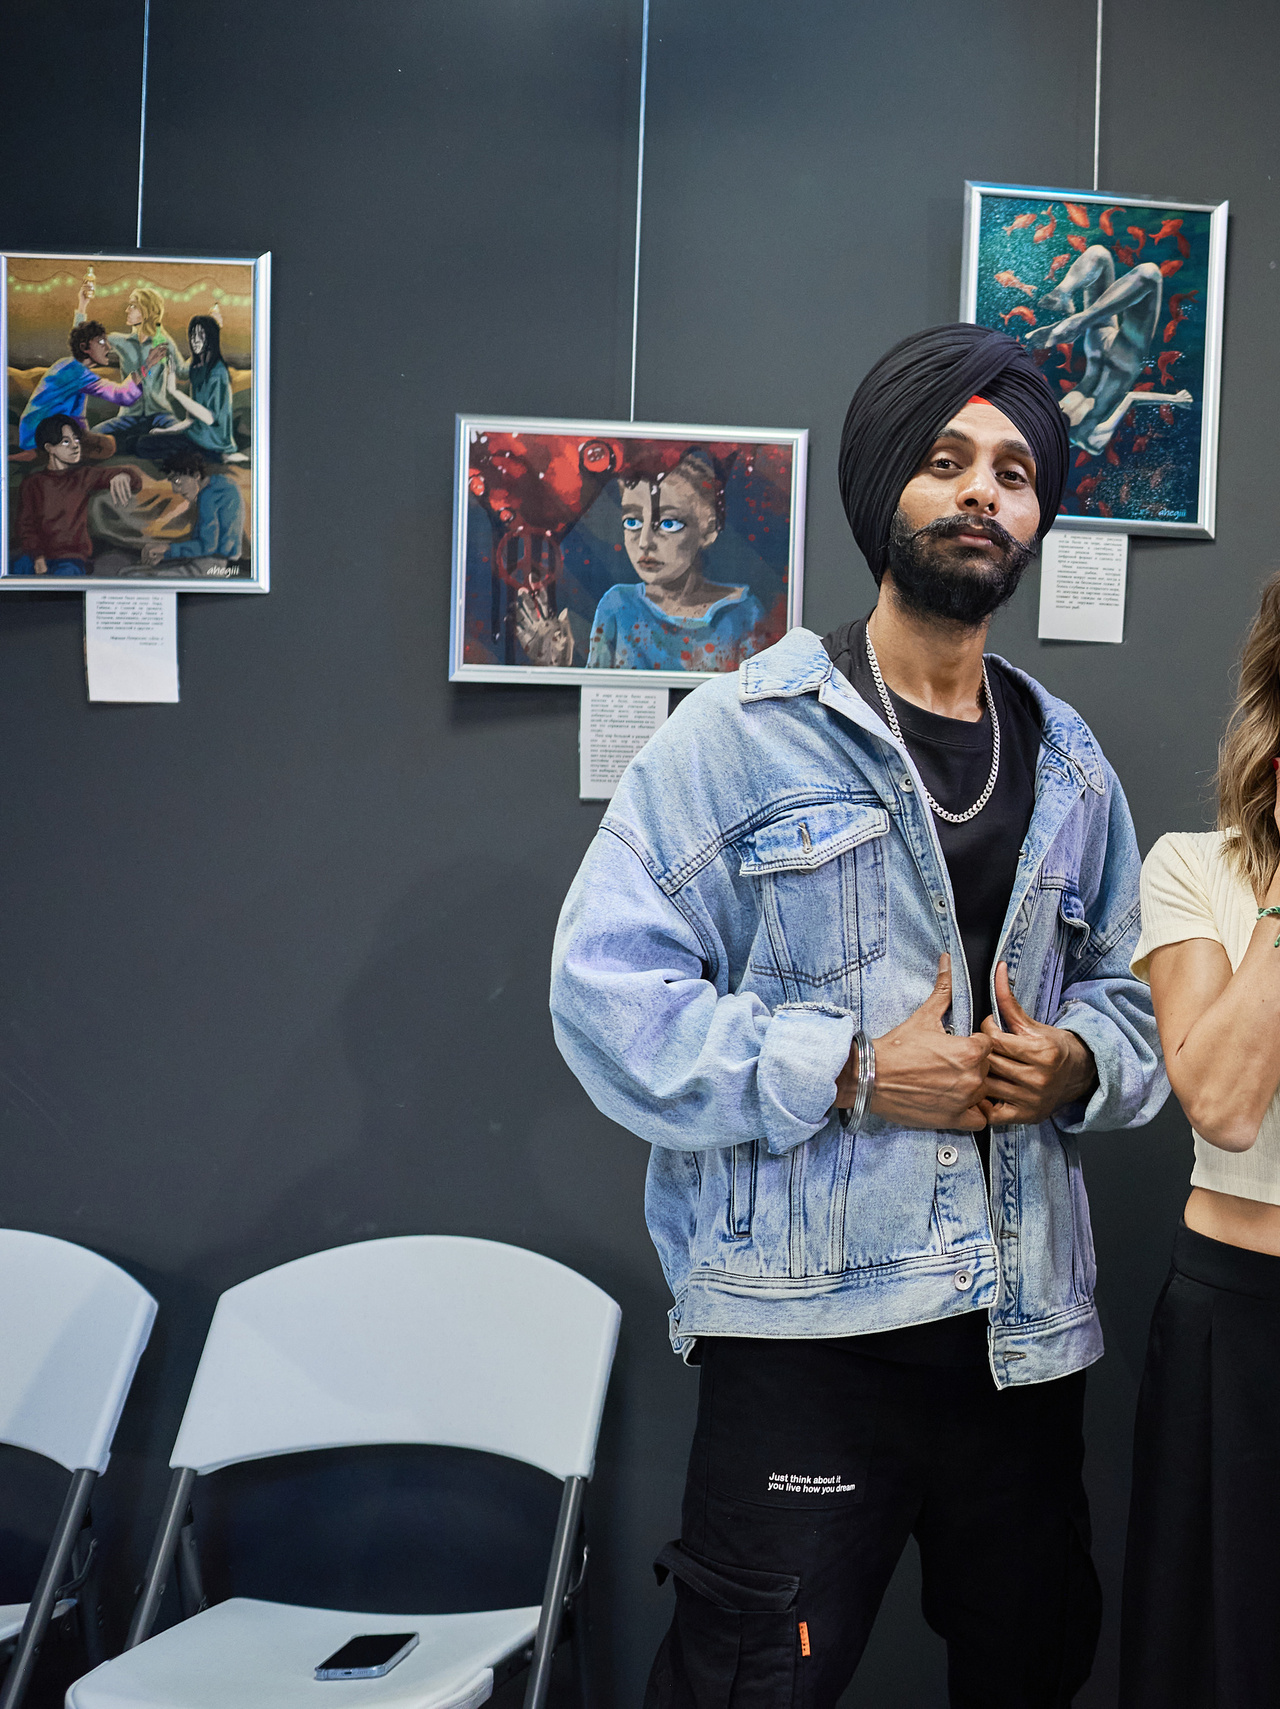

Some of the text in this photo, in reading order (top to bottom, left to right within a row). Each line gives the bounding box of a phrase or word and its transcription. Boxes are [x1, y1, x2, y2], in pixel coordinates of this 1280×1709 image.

[769, 1472, 841, 1484] Just think about it
[767, 1482, 855, 1495] you live how you dream
